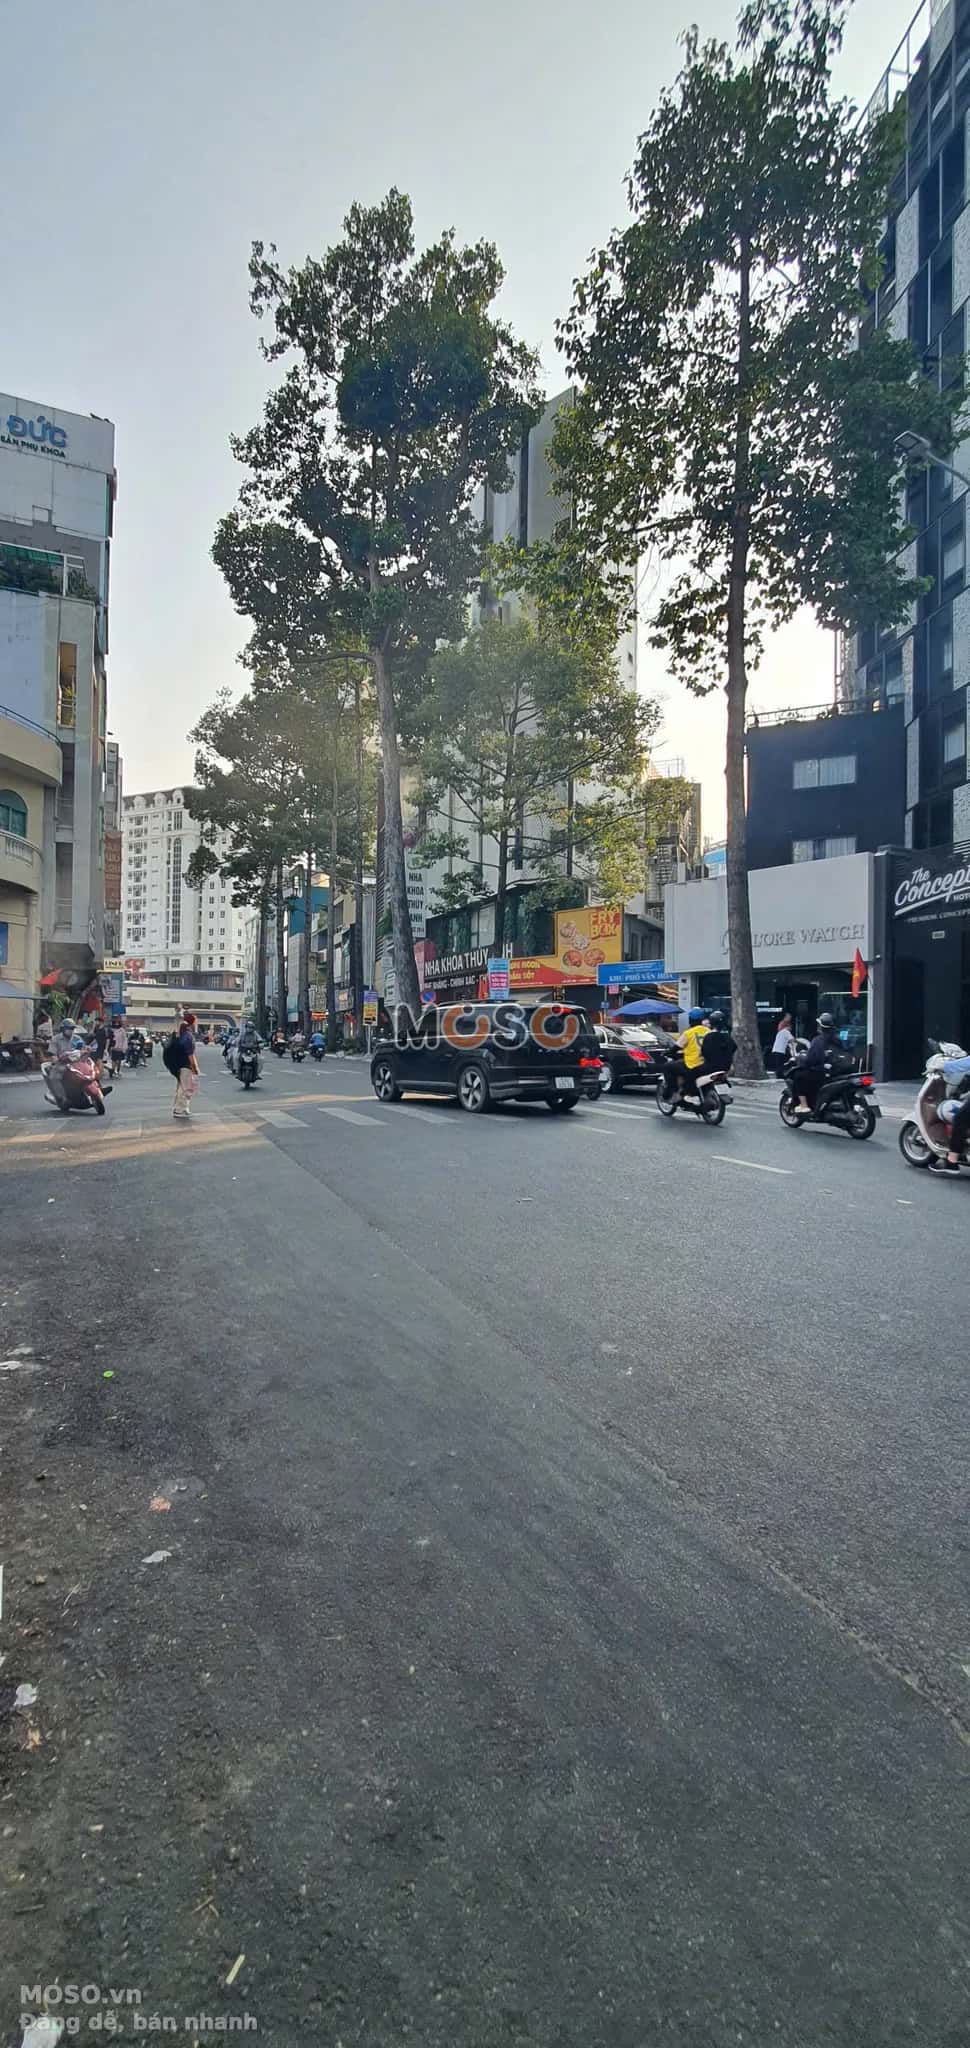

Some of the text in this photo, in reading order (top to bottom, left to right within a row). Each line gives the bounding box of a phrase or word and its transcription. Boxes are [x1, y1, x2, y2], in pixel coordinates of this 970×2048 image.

[7, 415, 67, 448] ĐỨC
[408, 872, 423, 882] NHA
[911, 868, 930, 885] The
[407, 886, 425, 896] KHOA
[800, 924, 865, 945] WATCH
[425, 960, 440, 977] NHA
[441, 954, 464, 974] KHOA
